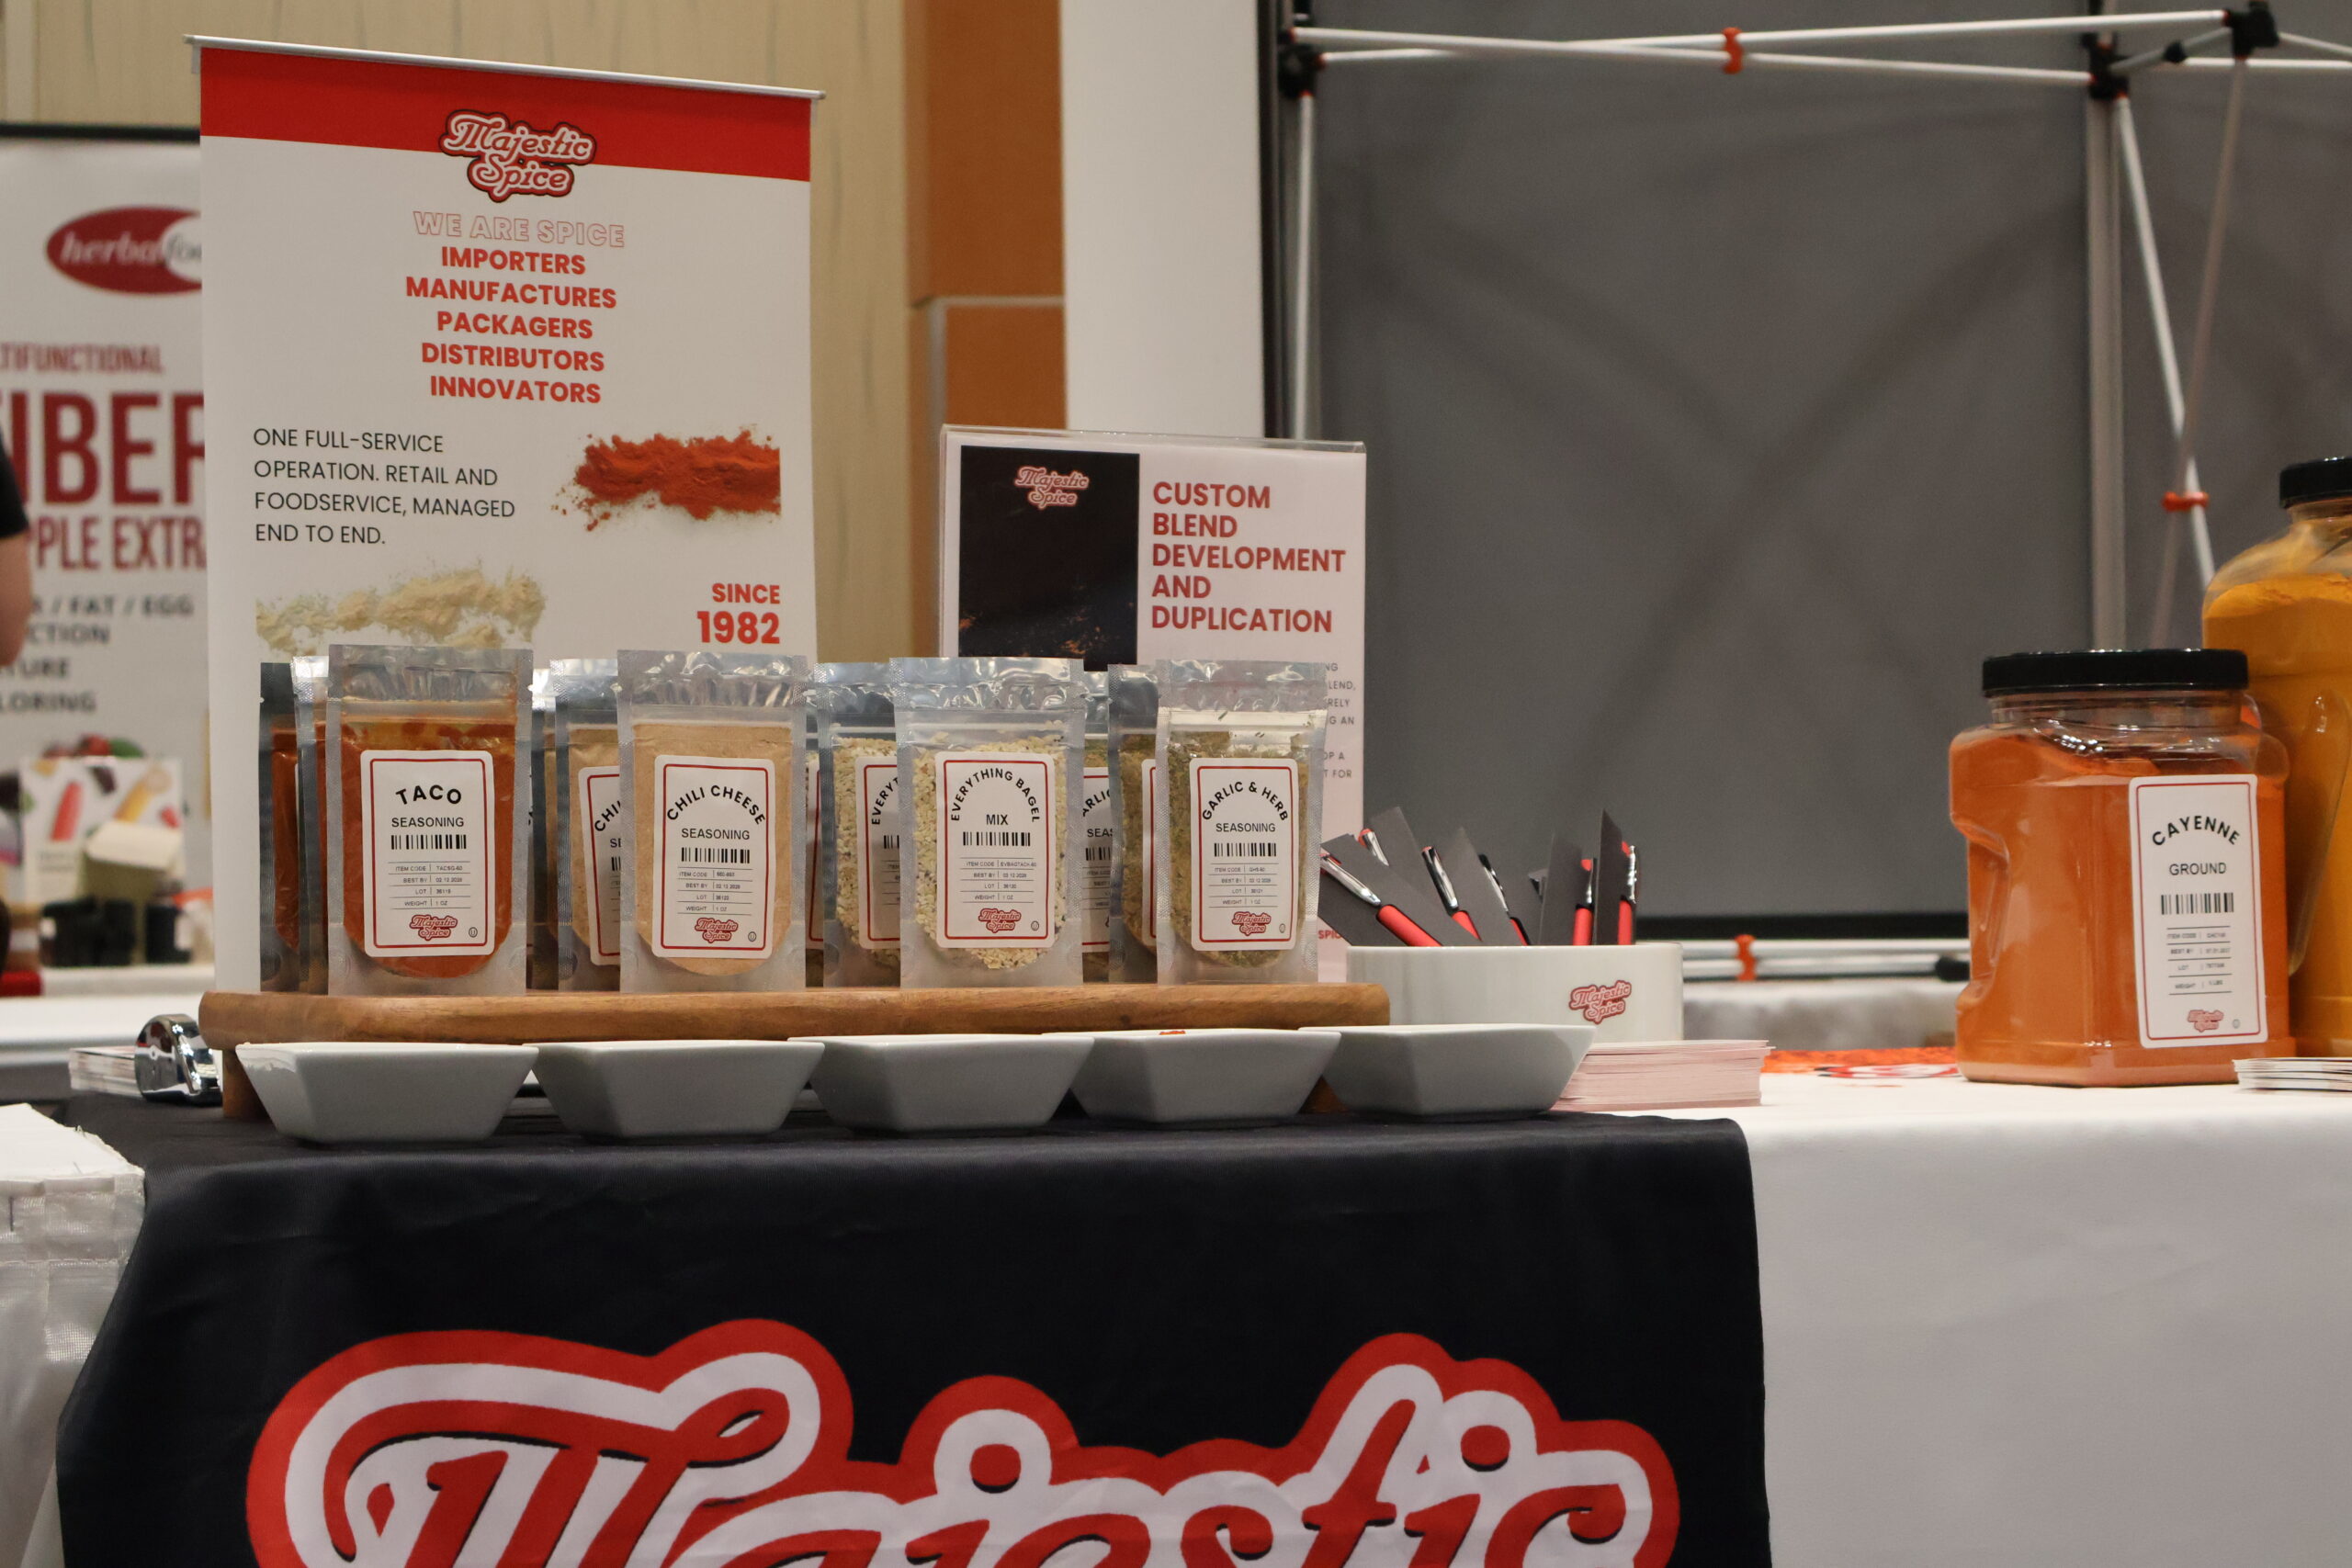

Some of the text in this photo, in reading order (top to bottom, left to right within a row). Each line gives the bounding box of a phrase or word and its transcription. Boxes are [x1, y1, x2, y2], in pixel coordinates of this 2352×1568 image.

[443, 113, 594, 164] Majestic
[471, 152, 571, 197] Spice
[413, 211, 626, 248] WE ARE SPICE
[441, 246, 586, 276] IMPORTERS
[406, 276, 616, 309] MANUFACTURES
[437, 310, 593, 339] PACKAGERS
[422, 342, 605, 372] DISTRIBUTORS
[430, 375, 602, 404] INNOVATORS
[254, 428, 444, 453] ONE FULL-SERVICE
[254, 460, 498, 486] OPERATION. RETAIL AND
[1014, 466, 1090, 491] Majestic
[255, 492, 515, 517] FOODSERVICE, MANAGED
[1027, 486, 1078, 510] Spice
[1152, 481, 1271, 509] CUSTOM
[255, 524, 386, 545] END TO END.
[1152, 513, 1238, 537] BLEND
[1152, 544, 1347, 572] DEVELOPMENT
[712, 582, 780, 604] SINCE
[1151, 575, 1212, 598] AND
[696, 611, 780, 644] 1982
[1151, 605, 1332, 633] DUPLICATION
[1340, 716, 1355, 725] AN
[1332, 769, 1352, 779] FOR
[395, 784, 462, 805] TACO
[666, 786, 706, 821] CHILI
[710, 784, 766, 825] CHEESE
[951, 768, 1041, 823] EVERYTHING BAGEL
[1202, 781, 1288, 821] GARLIC & HERB
[391, 817, 464, 829] SEASONING
[985, 814, 1009, 826] MIX
[1216, 822, 1276, 833] SEASONING
[2152, 815, 2240, 846] CAYENNE
[681, 828, 751, 840] SEASONING
[2168, 862, 2227, 876] GROUND
[412, 915, 457, 930] Majestic
[696, 919, 737, 931] Majestic
[979, 908, 1020, 921] Majestic
[987, 919, 1014, 932] Spice
[419, 926, 450, 940] Spice
[1572, 981, 1631, 1008] Majestic
[1585, 998, 1625, 1023] Spice
